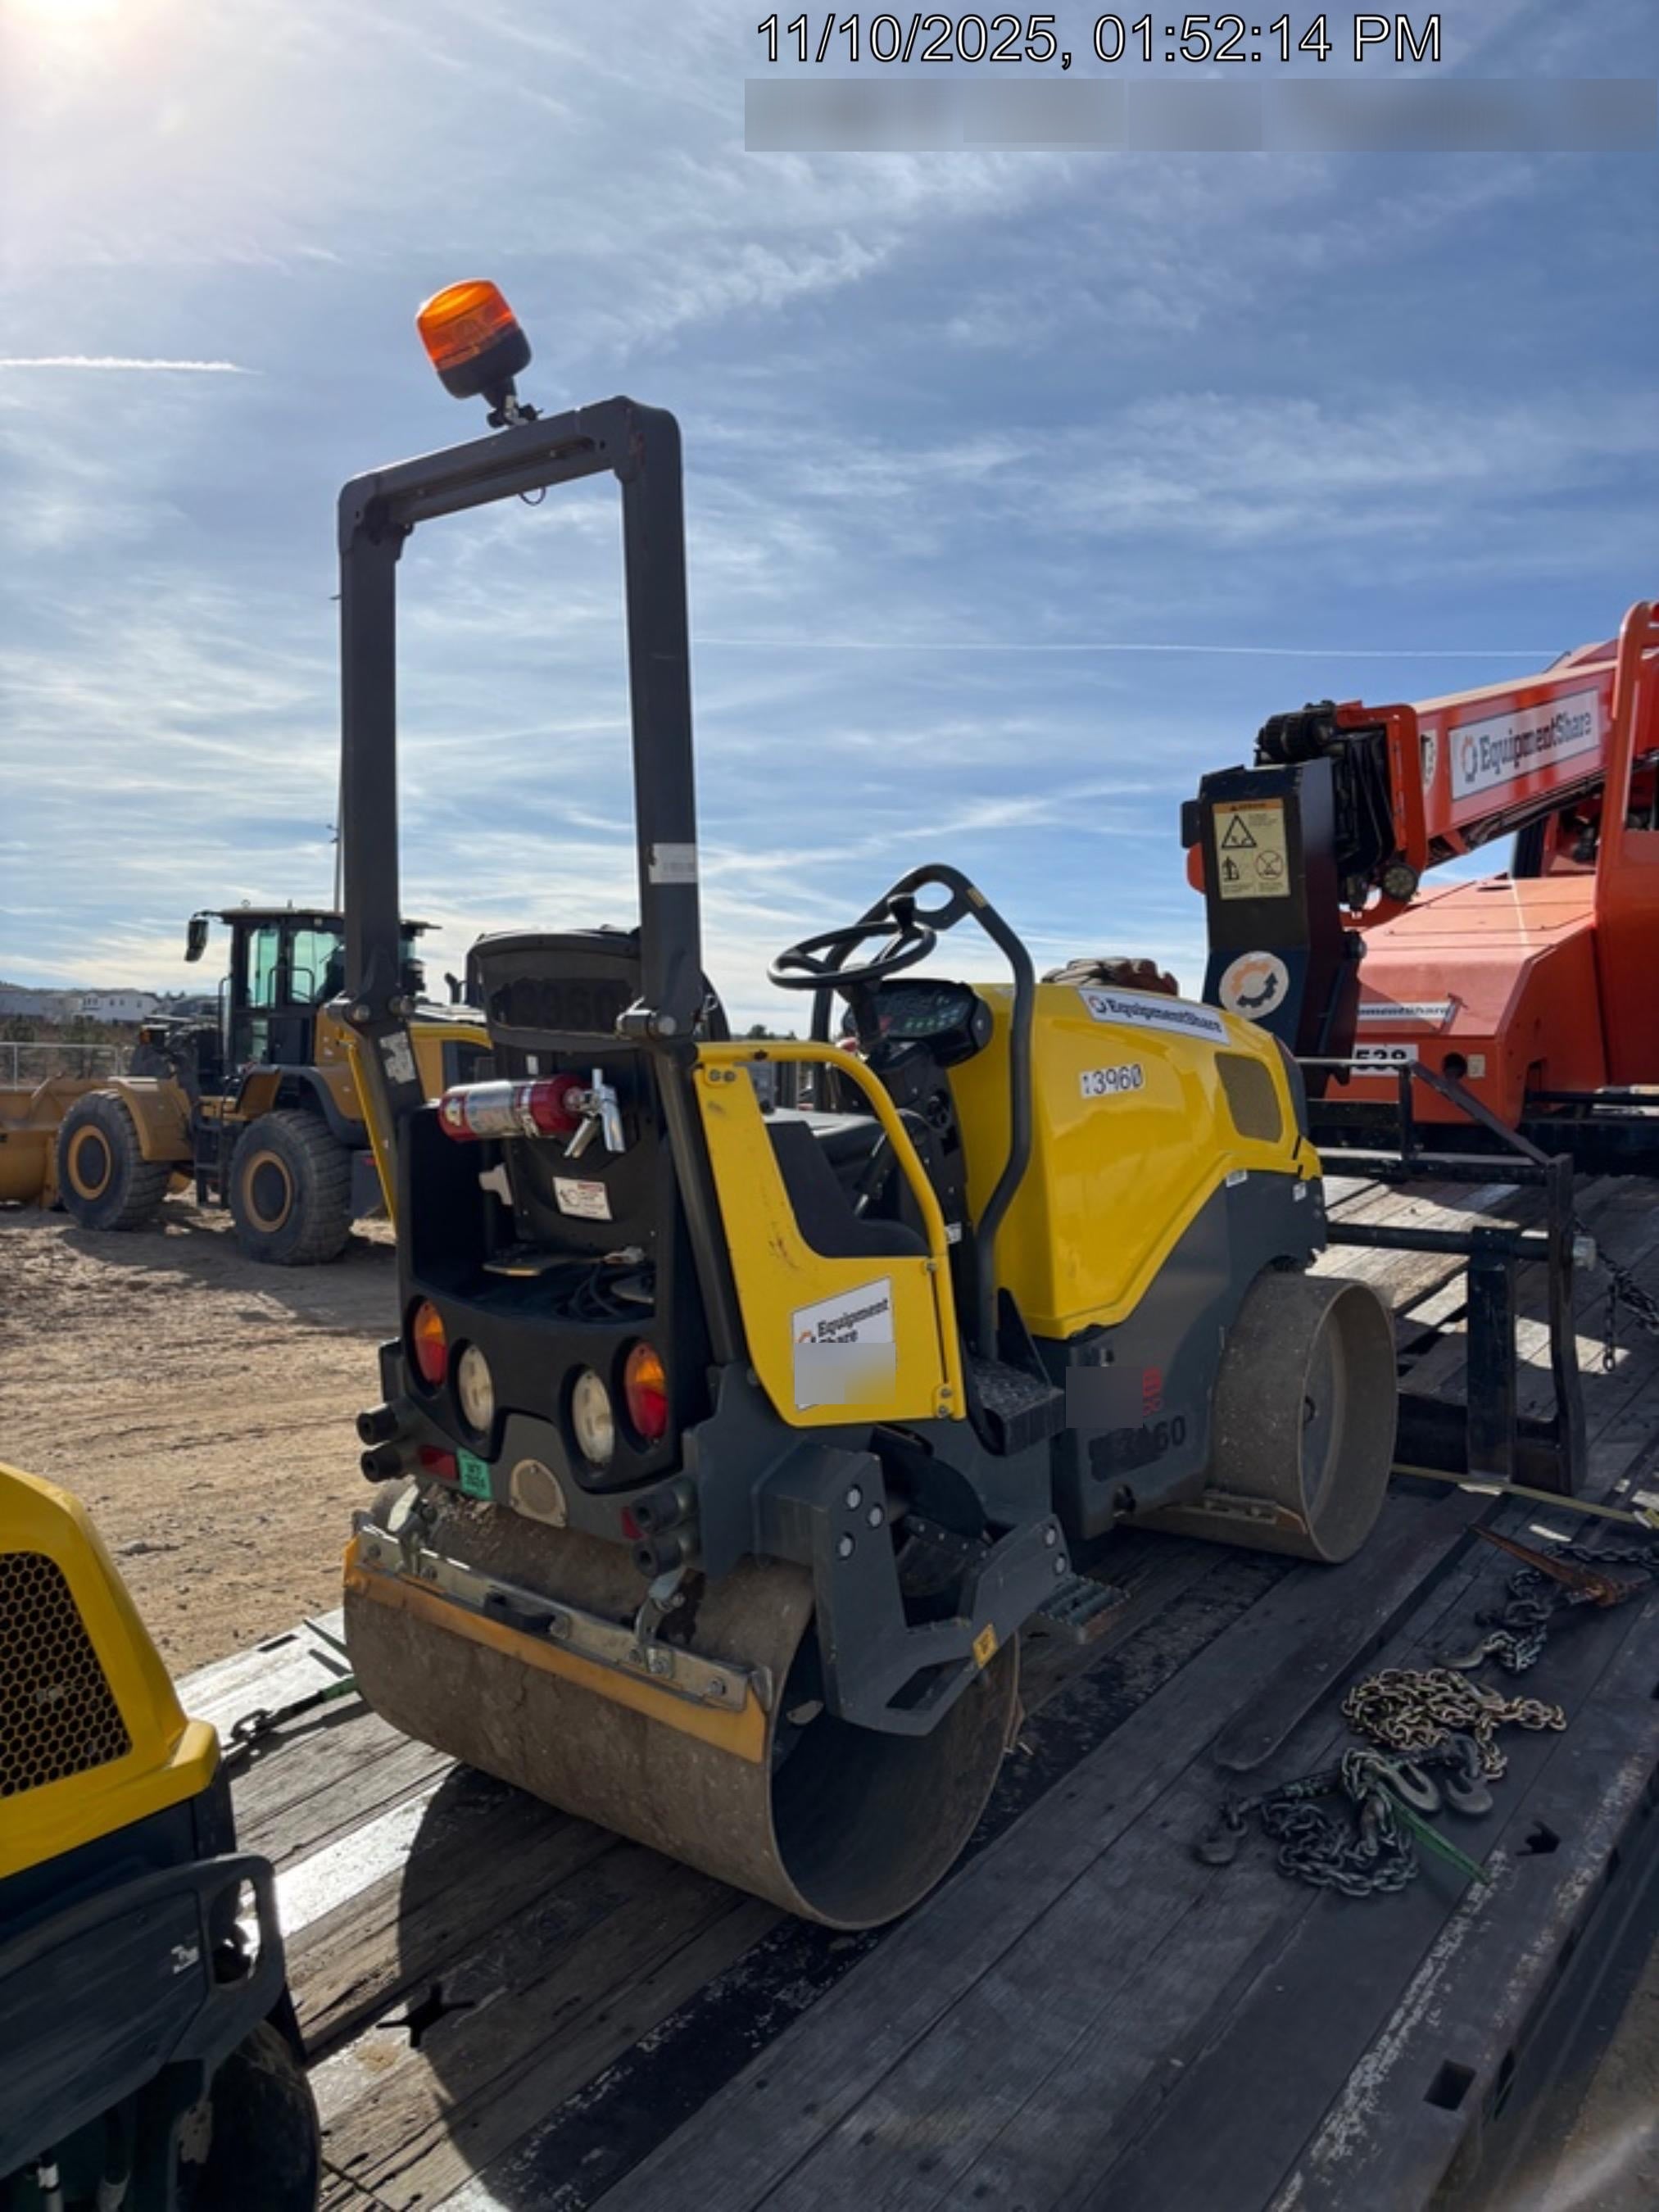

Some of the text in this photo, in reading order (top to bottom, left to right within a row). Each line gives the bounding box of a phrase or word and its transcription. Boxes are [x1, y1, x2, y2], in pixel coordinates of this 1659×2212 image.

[1479, 711, 1592, 775] EquipmentShare
[1106, 998, 1222, 1033] EquipmentShare
[818, 1298, 890, 1337] Equipment
